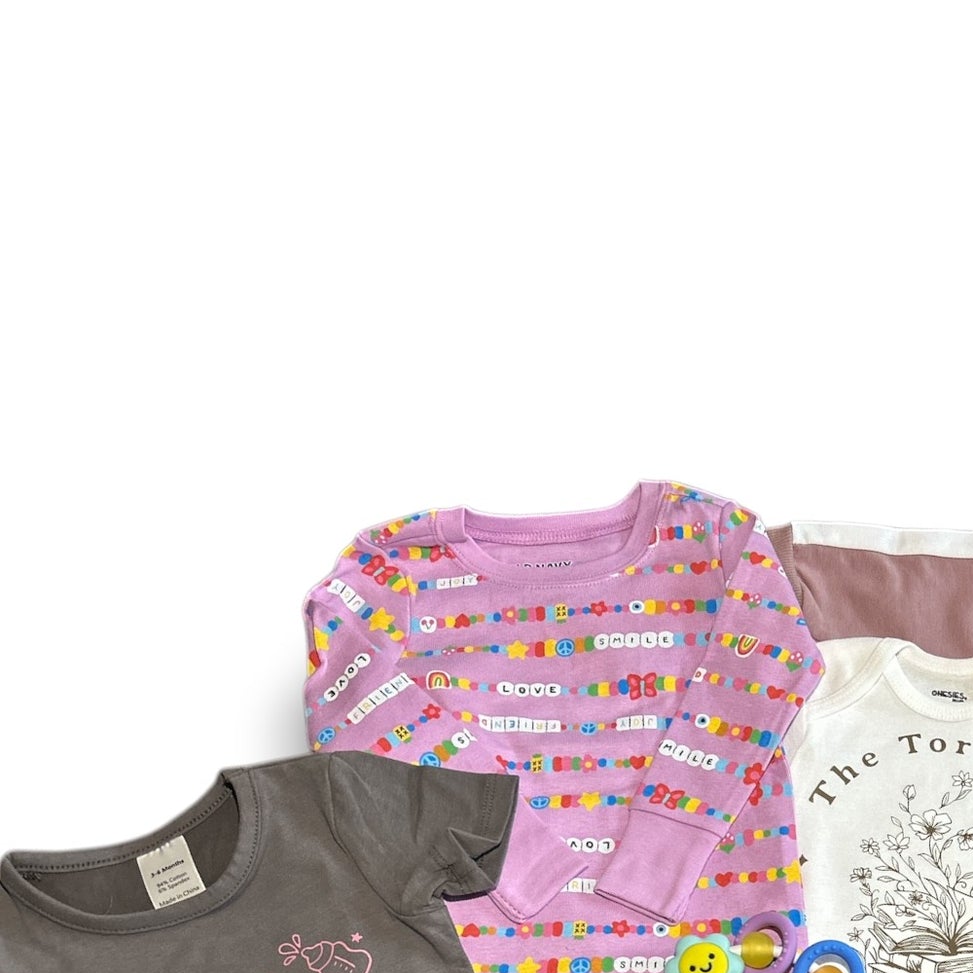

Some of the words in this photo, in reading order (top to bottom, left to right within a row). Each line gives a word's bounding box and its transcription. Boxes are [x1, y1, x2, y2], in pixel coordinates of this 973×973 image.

[439, 576, 475, 588] JOY
[331, 582, 362, 608] JOY
[598, 634, 670, 646] SMILE
[327, 654, 368, 698] LOVE
[501, 683, 558, 695] LOVE
[352, 680, 404, 720] FRIEN
[481, 718, 557, 731] FRIEND
[618, 717, 655, 729] JOY
[662, 742, 715, 767] MILE
[808, 751, 880, 806] The
[569, 840, 611, 849] LOV
[161, 859, 184, 872] Months
[159, 897, 176, 906] Made
[183, 886, 199, 896] China
[619, 959, 658, 970] SMI
